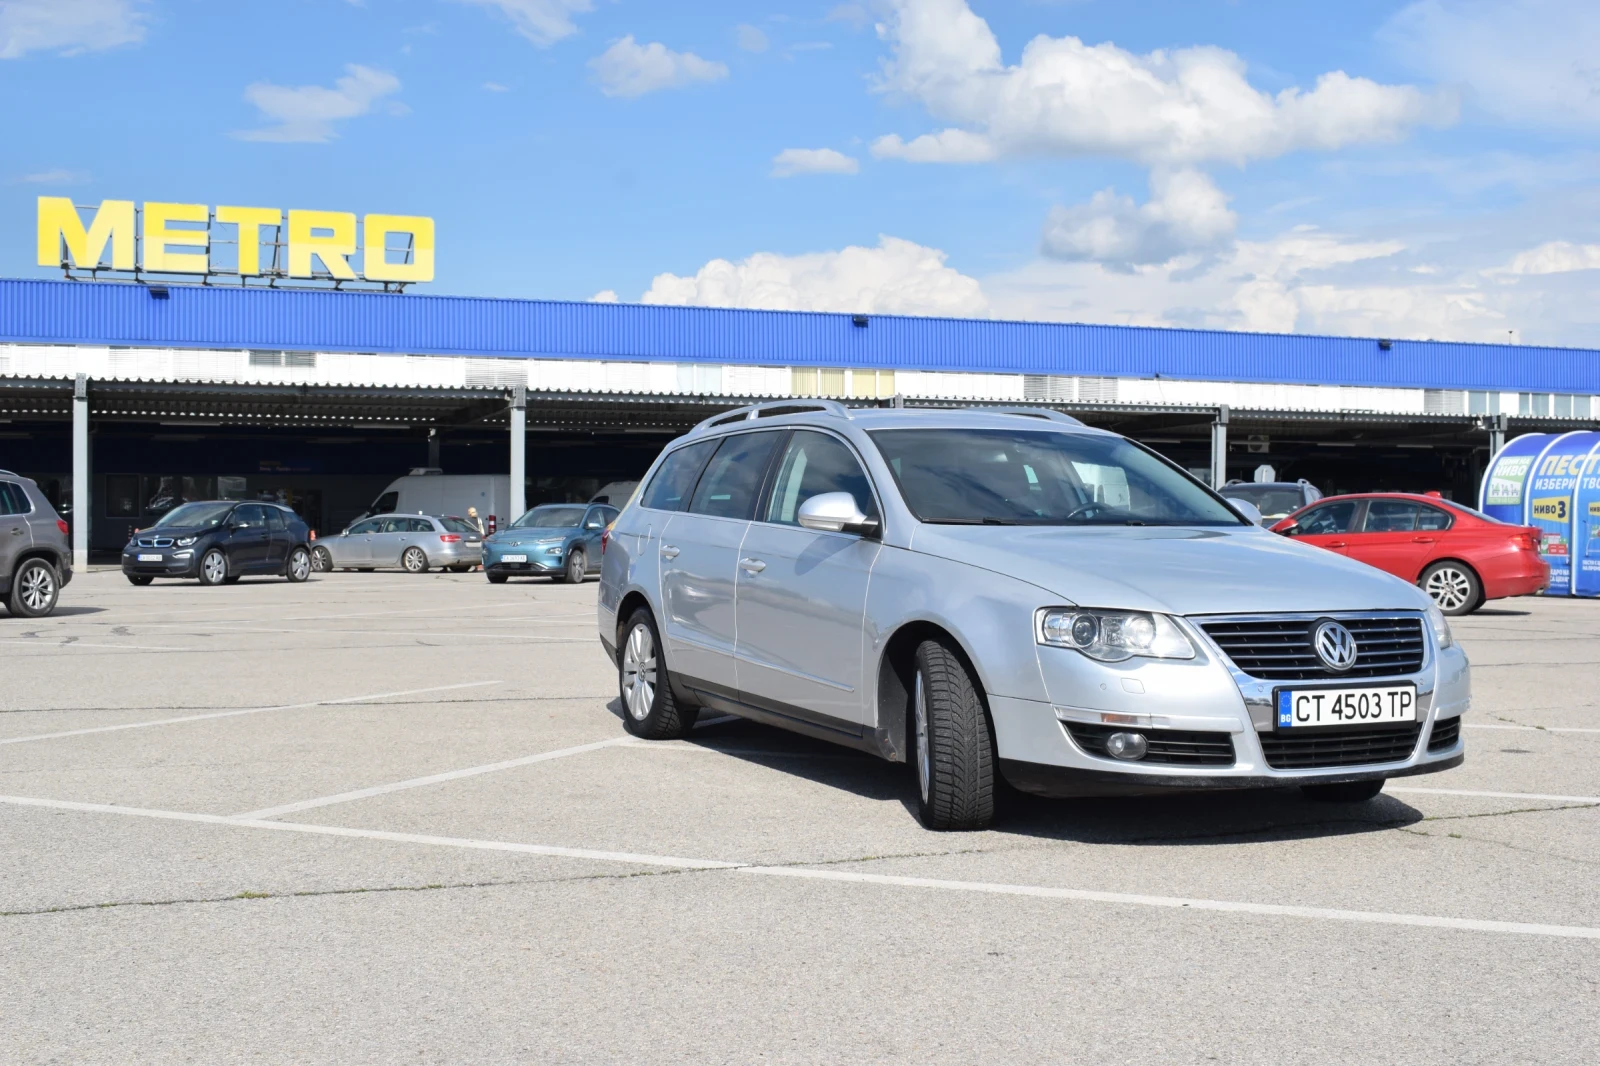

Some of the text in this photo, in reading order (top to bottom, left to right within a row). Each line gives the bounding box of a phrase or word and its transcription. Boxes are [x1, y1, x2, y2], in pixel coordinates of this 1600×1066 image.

[37, 196, 435, 282] METRO
[1534, 478, 1576, 490] ИЗБЕРИ
[1533, 500, 1567, 519] НИВО 3
[1280, 690, 1412, 723] BG CT 4503 TP
